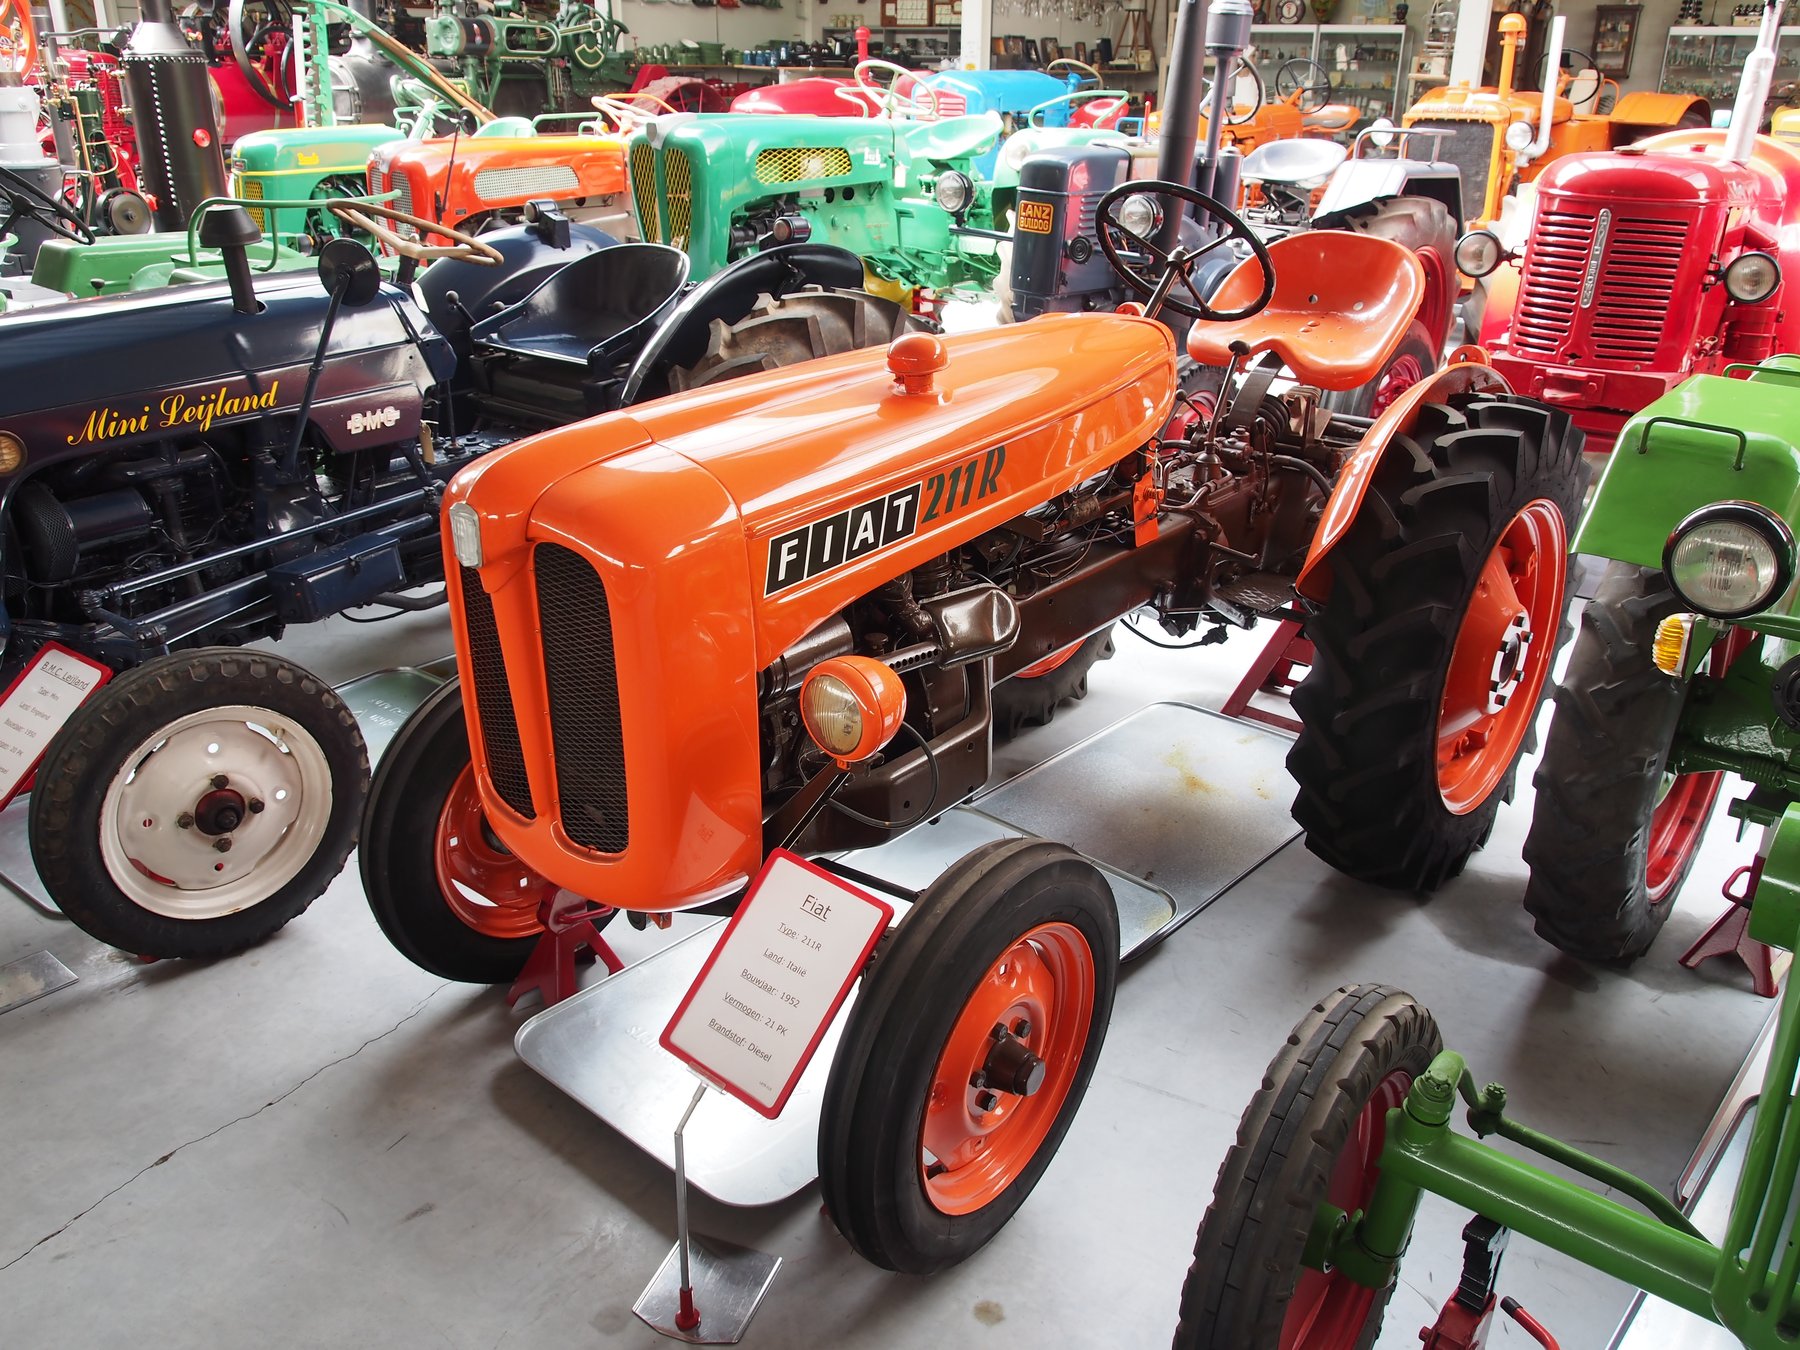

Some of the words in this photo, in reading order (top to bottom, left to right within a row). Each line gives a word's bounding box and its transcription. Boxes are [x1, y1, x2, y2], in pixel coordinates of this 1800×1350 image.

[1020, 203, 1051, 219] LANZ
[1020, 216, 1049, 231] BULLDOG
[1594, 216, 1608, 255] DAVID
[1583, 260, 1598, 299] BROWN
[67, 406, 149, 446] Mini
[159, 381, 279, 433] Leijland
[777, 493, 913, 582] FIAT
[920, 445, 1006, 525] 211R
[800, 894, 832, 922] Fiat
[778, 922, 800, 940] Type:
[801, 935, 823, 952] 211R
[763, 947, 786, 966] Land:
[786, 960, 808, 978] Italië
[740, 968, 779, 996] Bouwjaar:
[780, 991, 801, 1009] 1952
[722, 992, 764, 1022] Vermogen:
[764, 1017, 776, 1029] 21
[776, 1024, 789, 1037] PK
[708, 1018, 747, 1047] Brandstof:
[747, 1042, 773, 1063] Diesel
